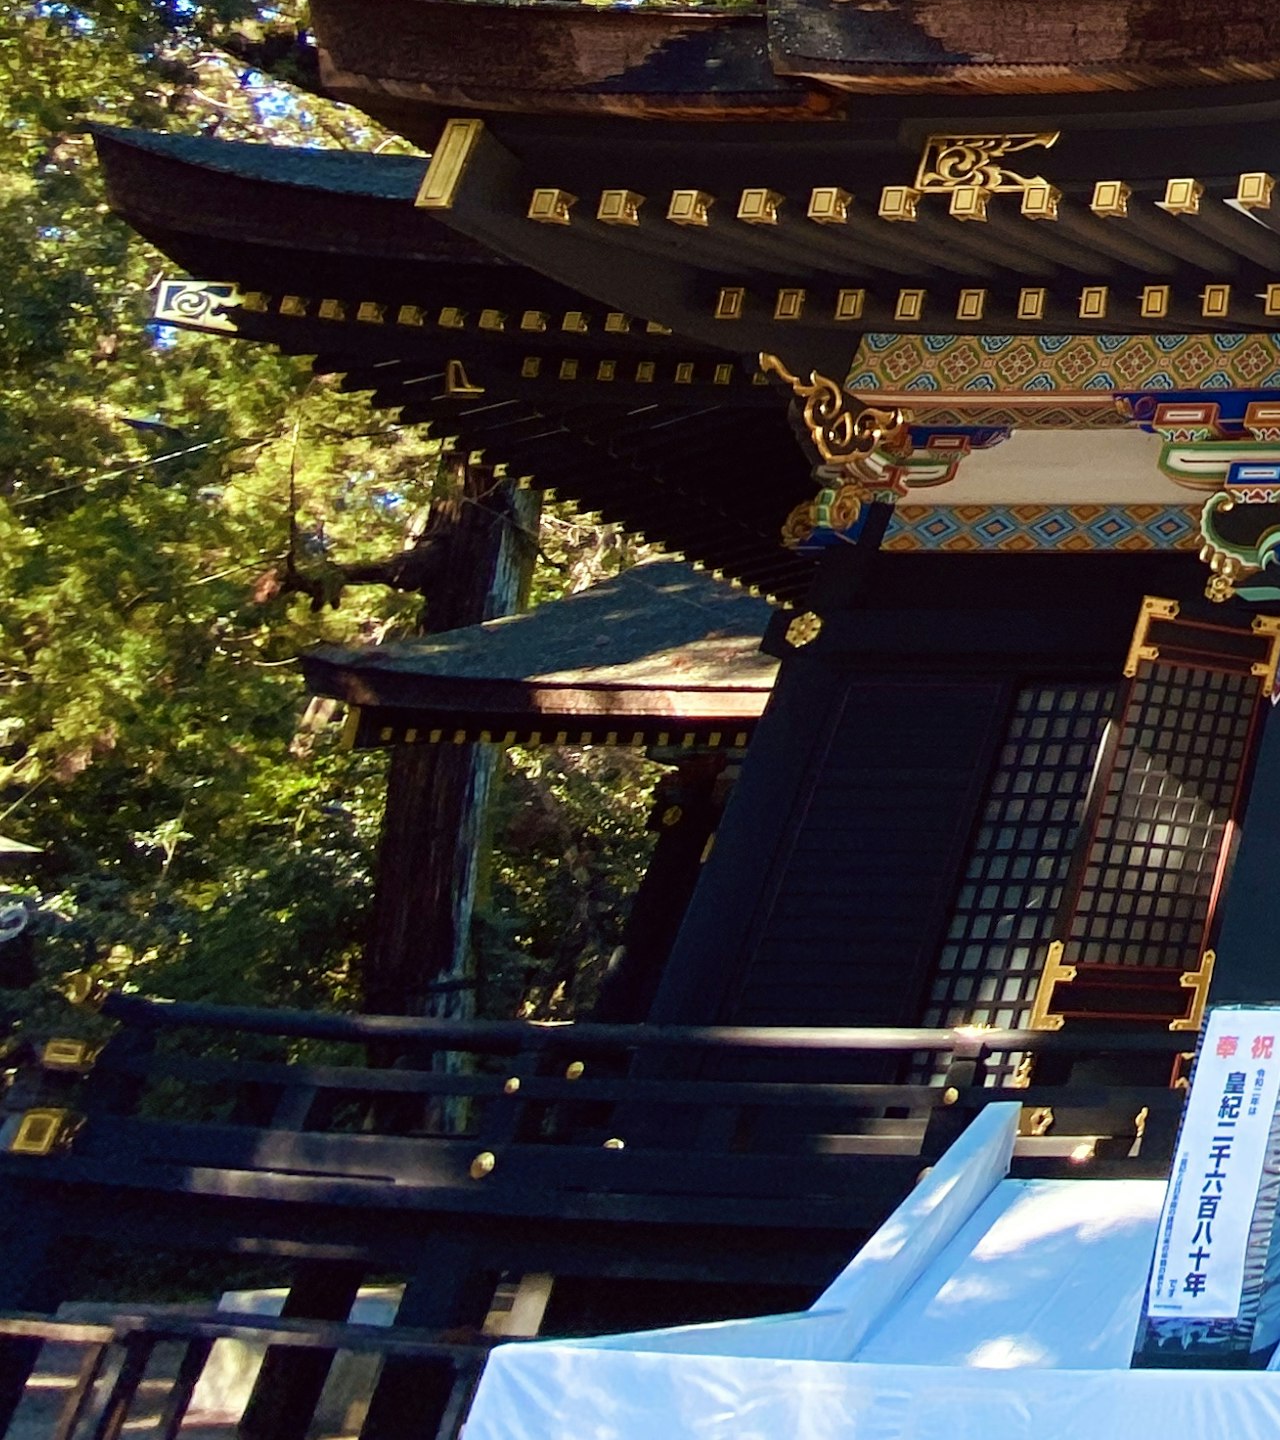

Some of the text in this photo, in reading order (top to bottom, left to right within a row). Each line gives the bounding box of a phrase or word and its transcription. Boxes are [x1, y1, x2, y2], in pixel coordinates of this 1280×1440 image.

[1215, 1035, 1274, 1059] 奉祝
[1183, 1071, 1246, 1298] 皇紀二千六百八十年
